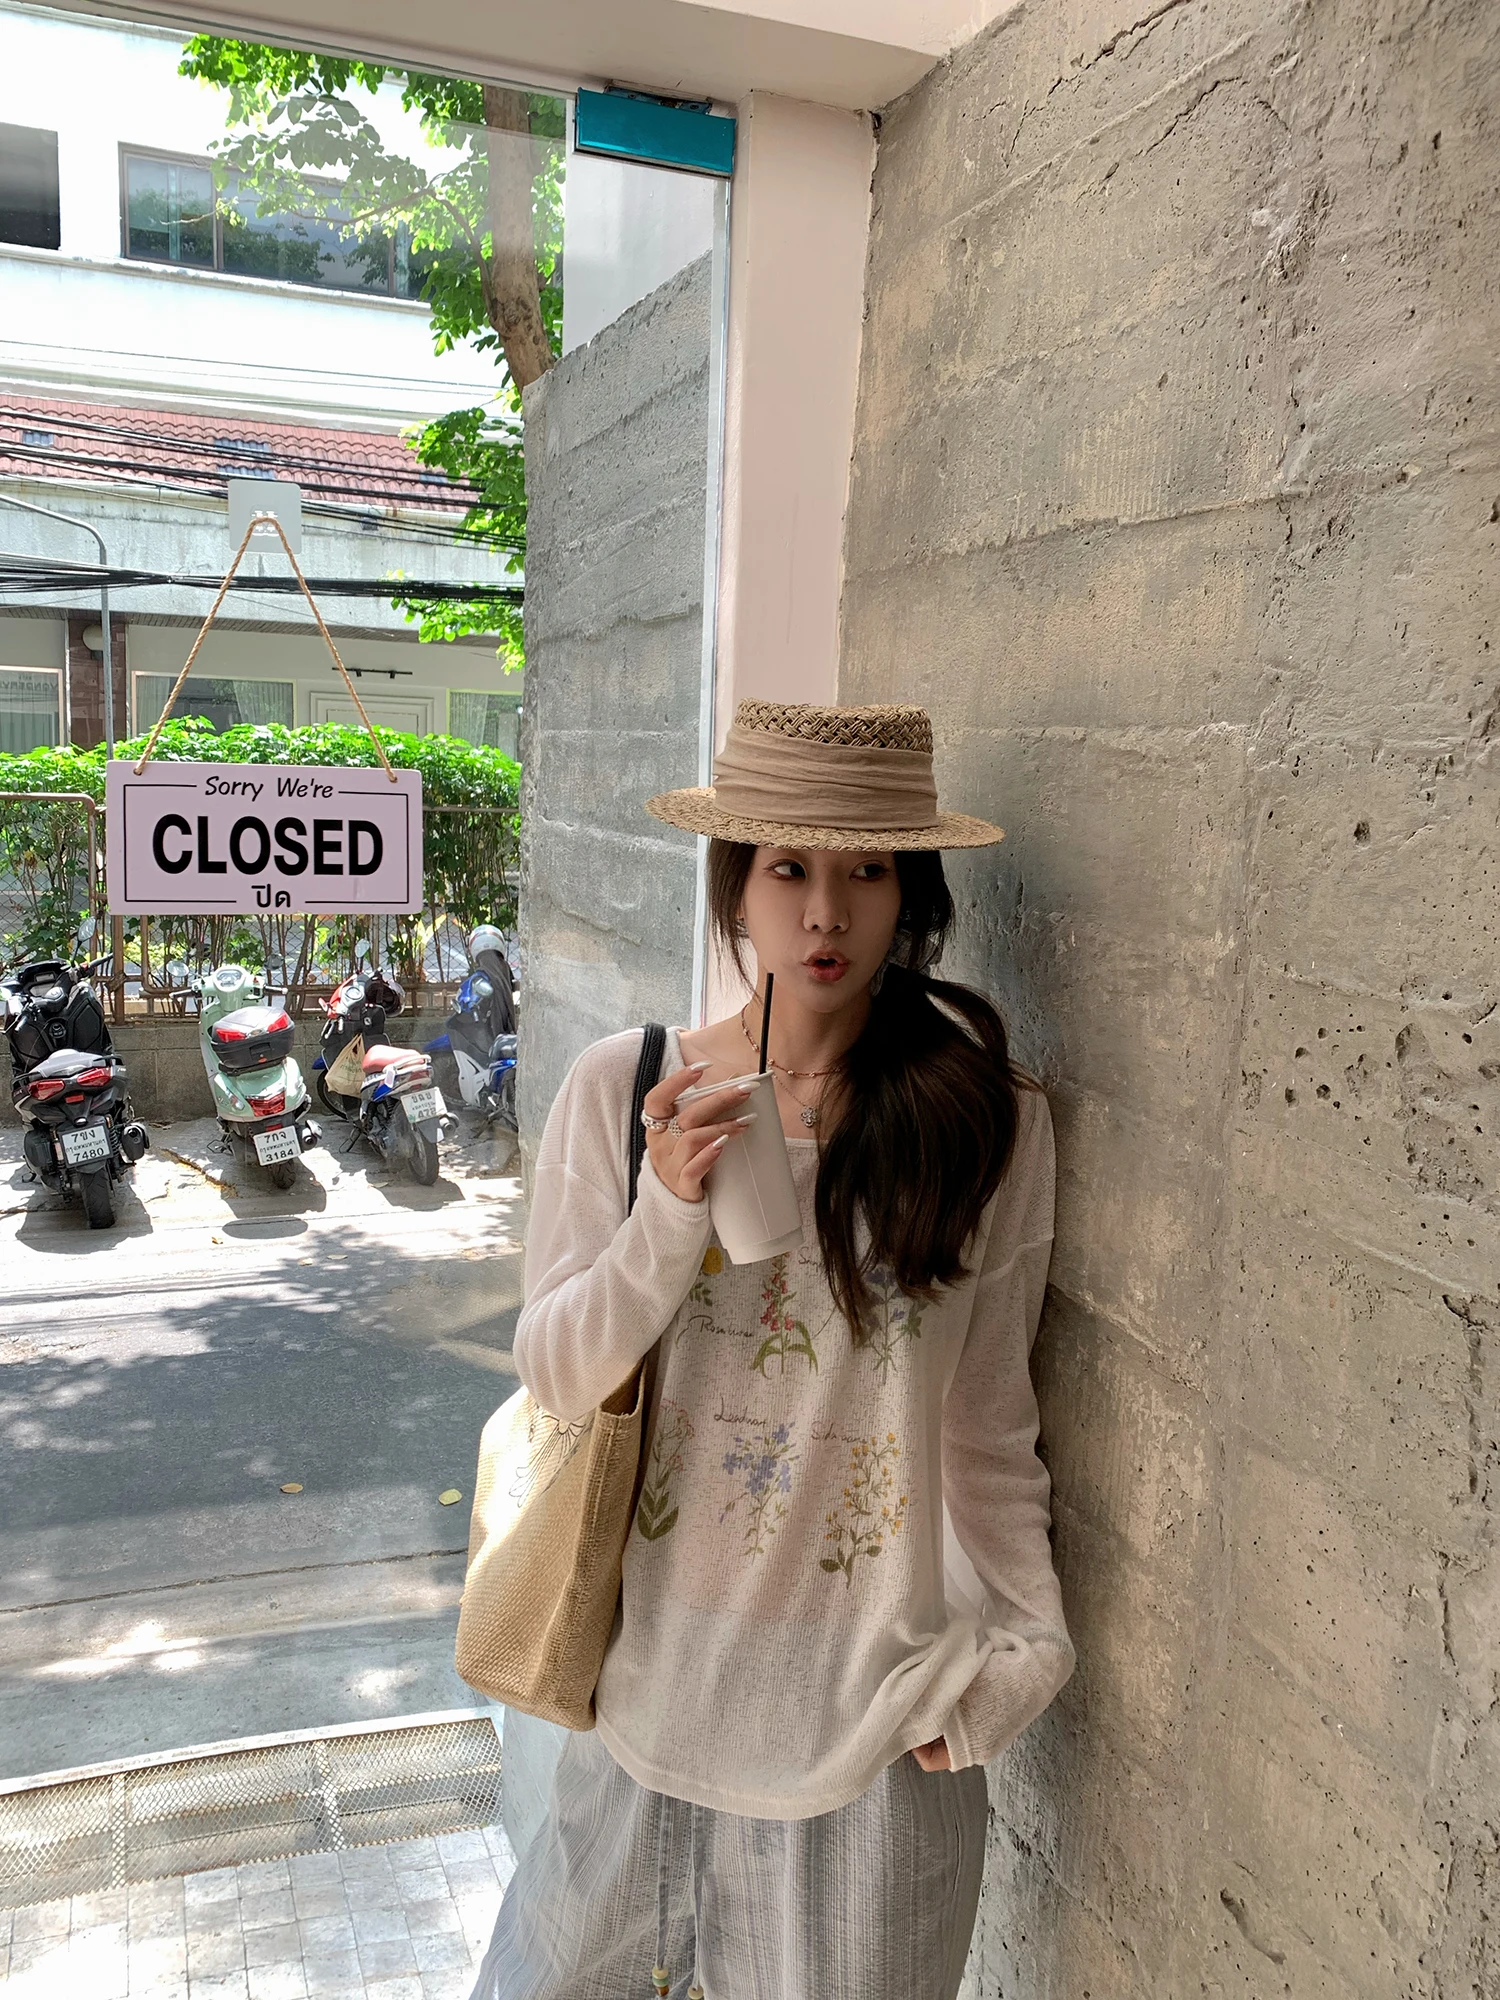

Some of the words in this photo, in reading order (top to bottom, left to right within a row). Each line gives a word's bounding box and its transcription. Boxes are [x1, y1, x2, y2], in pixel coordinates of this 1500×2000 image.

[204, 775, 264, 801] Sorry
[276, 777, 334, 799] We're
[152, 813, 384, 876] CLOSED
[251, 883, 291, 908] ปิด
[264, 1131, 286, 1143] 7กจ
[73, 1147, 104, 1162] 7480
[266, 1148, 294, 1162] 3184
